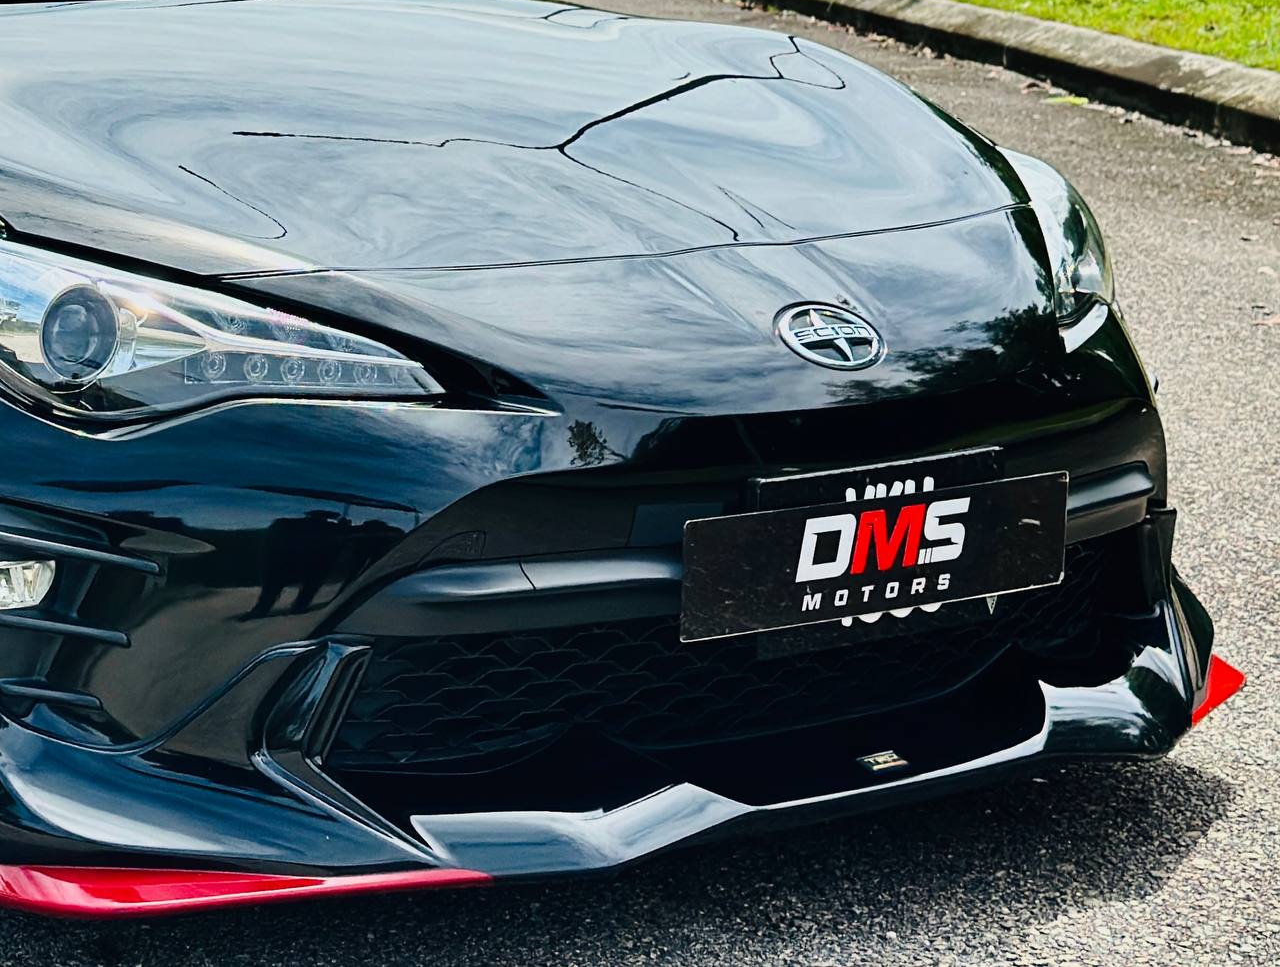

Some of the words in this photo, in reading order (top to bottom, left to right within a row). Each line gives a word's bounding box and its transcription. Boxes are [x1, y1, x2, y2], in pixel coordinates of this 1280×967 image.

[794, 325, 872, 342] SCION
[795, 497, 971, 583] DMS
[801, 573, 951, 612] MOTORS
